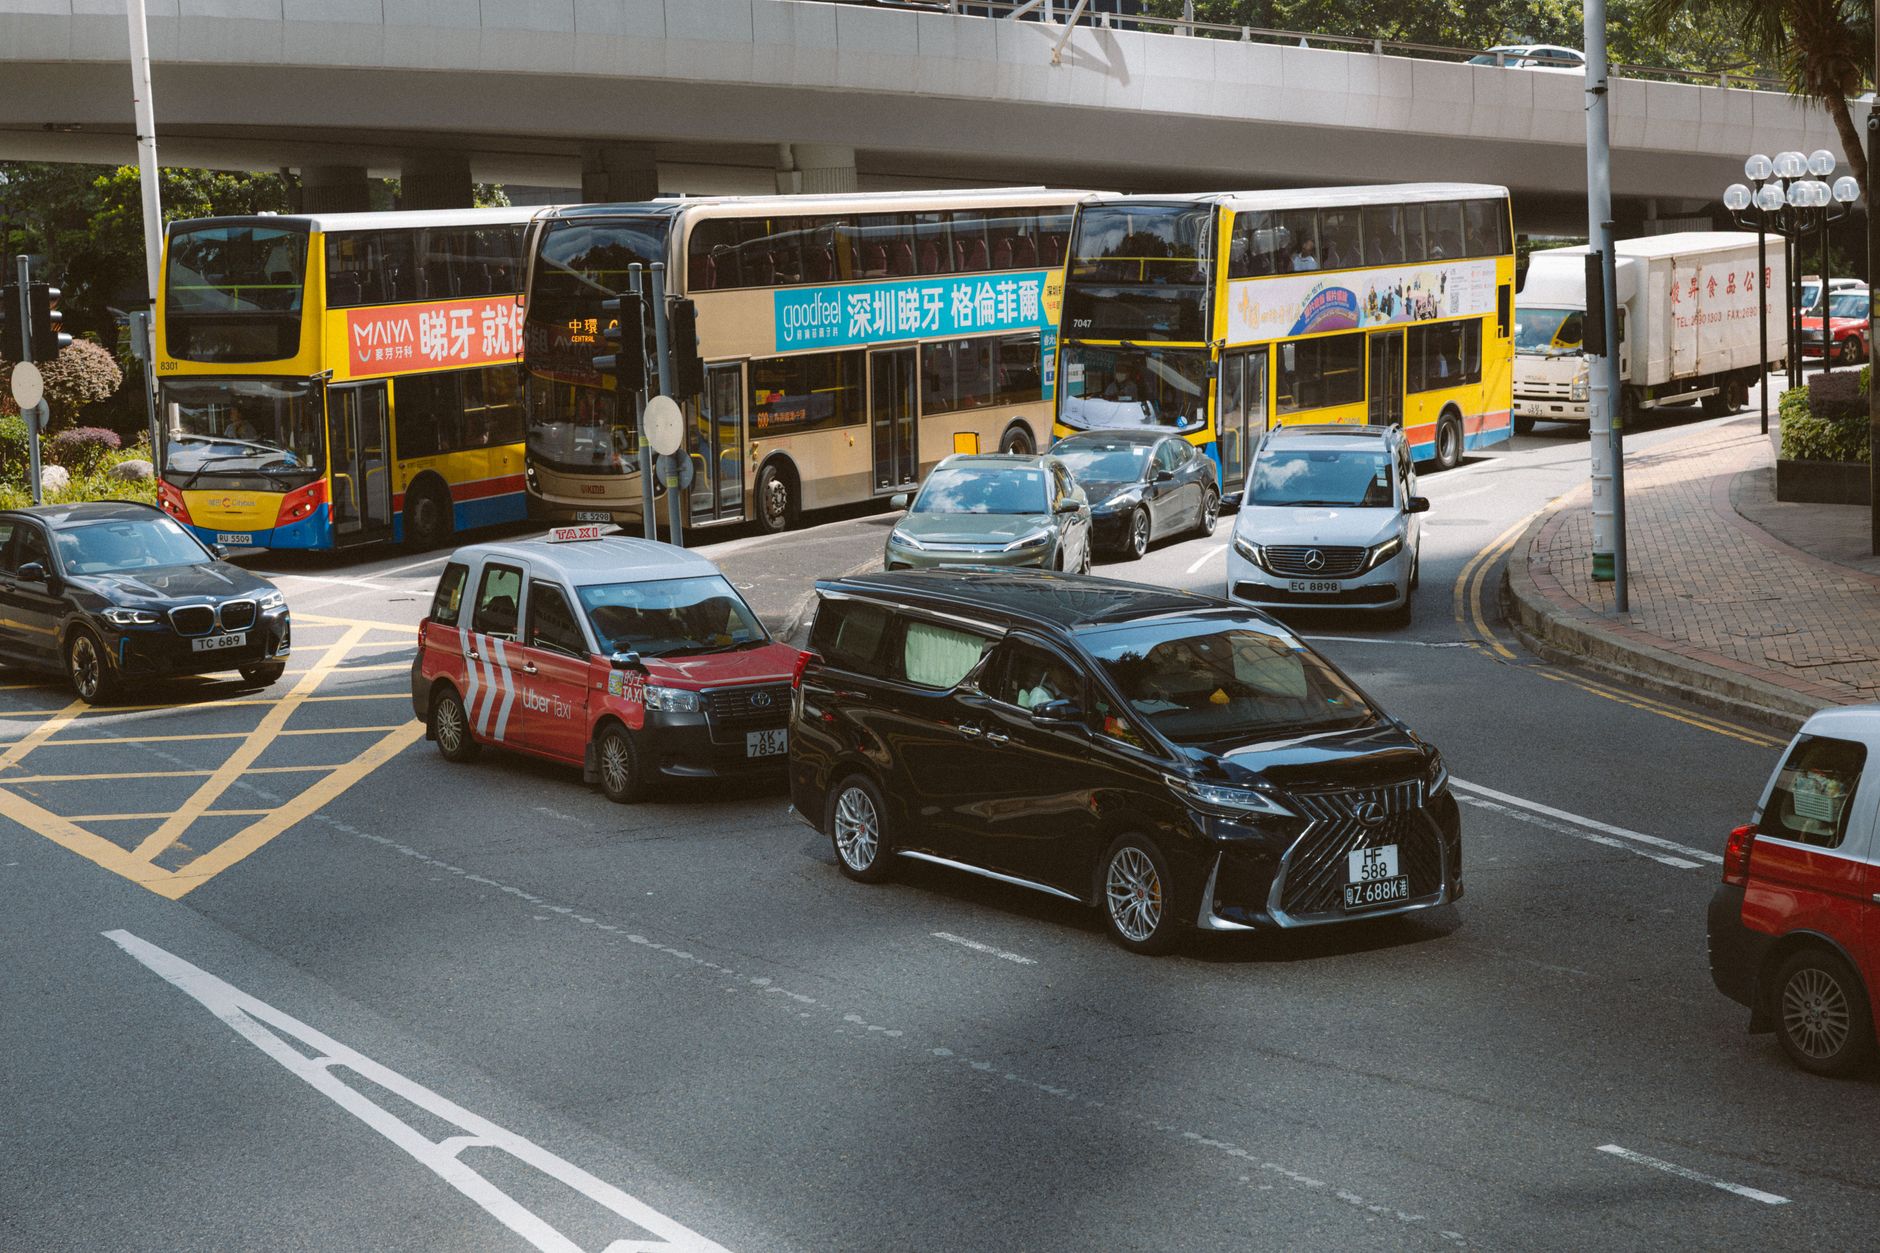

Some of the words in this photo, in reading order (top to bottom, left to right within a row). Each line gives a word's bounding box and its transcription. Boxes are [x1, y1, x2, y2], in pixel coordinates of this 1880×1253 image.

[783, 291, 841, 342] goodfeel
[847, 286, 944, 338] 深圳睇牙
[951, 280, 1039, 328] 格倫菲爾
[568, 318, 598, 334] 中環
[1073, 319, 1092, 328] 7047
[353, 319, 414, 347] MAIYA
[419, 308, 476, 362] 睇牙
[571, 335, 595, 343] CENTRAL
[160, 362, 178, 371] 8301
[590, 513, 609, 521] 5298
[219, 534, 229, 542] RU
[231, 535, 250, 543] 5509
[556, 527, 598, 540] TAXI
[1291, 582, 1305, 591] EG
[1310, 582, 1338, 591] 8898
[198, 638, 214, 649] TC
[218, 635, 240, 647] 689
[623, 670, 645, 687] 的士
[622, 686, 643, 704] TAXI
[522, 687, 550, 713] Uber
[552, 694, 572, 719] Taxi
[759, 730, 775, 745] XK
[750, 741, 785, 756] 7854
[1364, 847, 1383, 865] HF
[1361, 862, 1388, 880] 588
